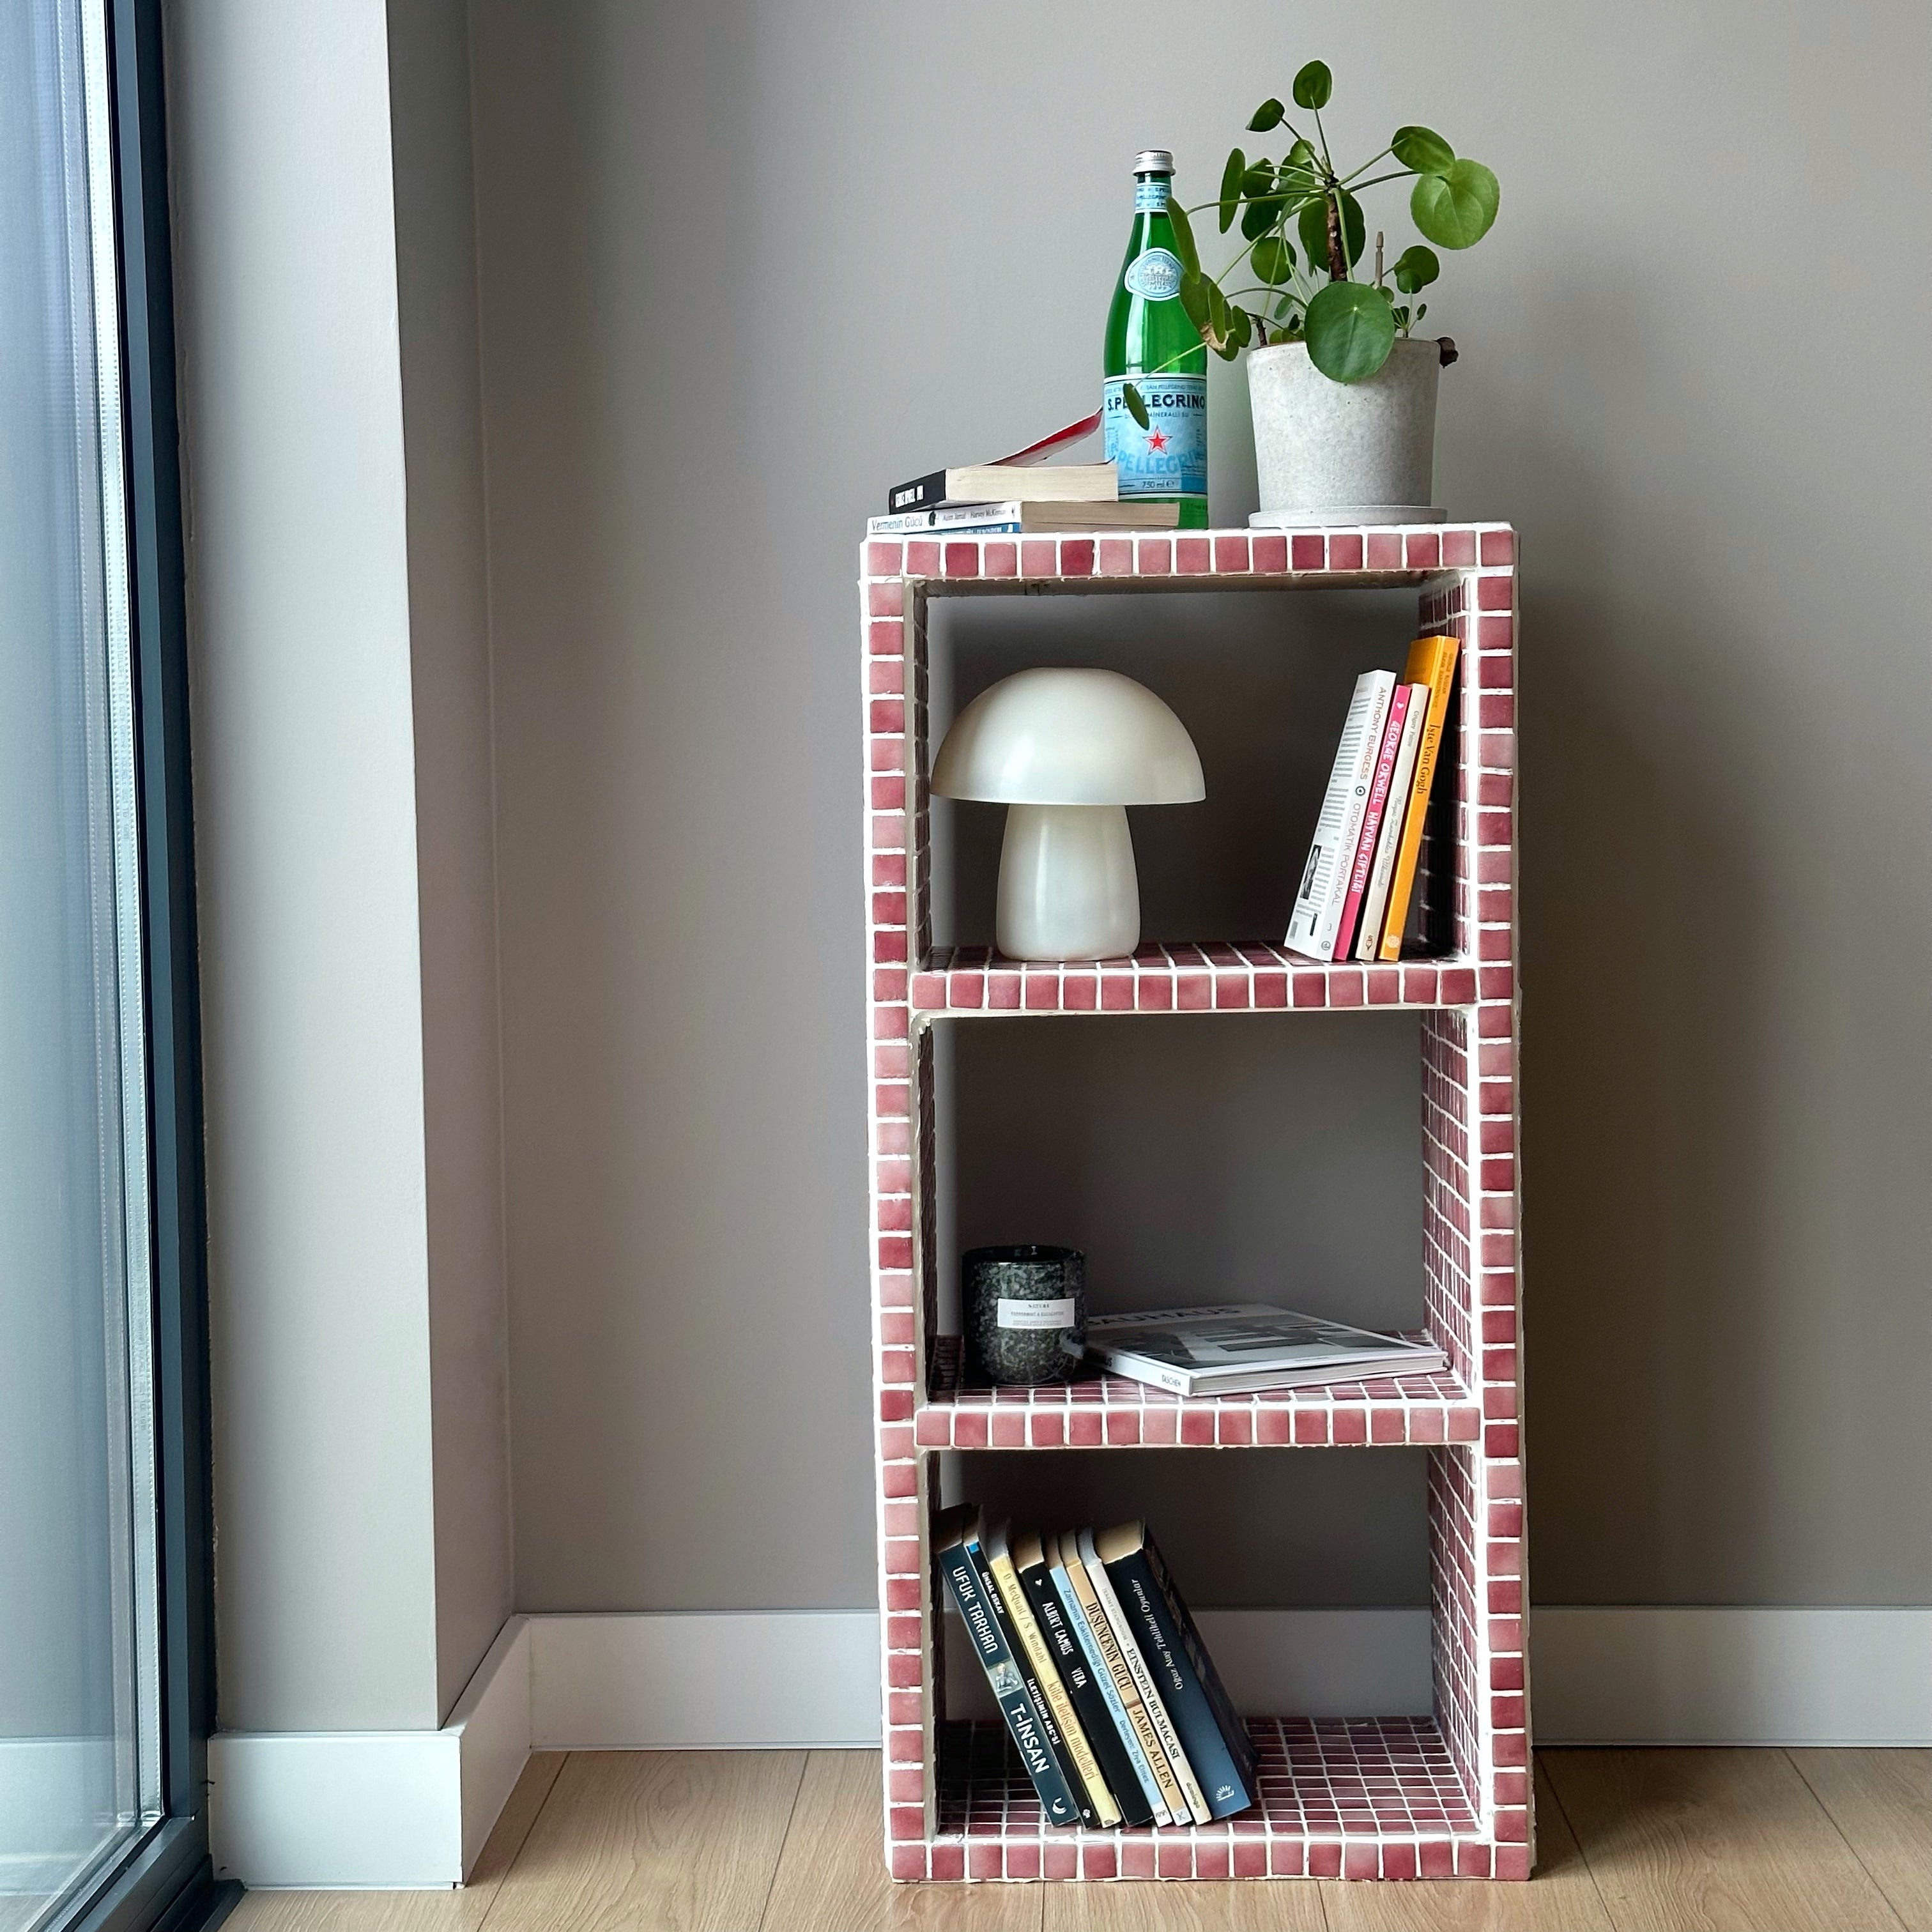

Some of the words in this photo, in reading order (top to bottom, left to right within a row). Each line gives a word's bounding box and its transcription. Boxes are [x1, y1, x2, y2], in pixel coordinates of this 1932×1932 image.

[1371, 686, 1387, 733] ANTHONY
[1382, 719, 1402, 762] GEORGE
[1422, 745, 1436, 765] Van
[1372, 763, 1390, 805] ORWELL
[1416, 767, 1430, 794] Gogh
[1344, 802, 1361, 852] OTOMATİK
[1360, 810, 1380, 852] HAYVAN
[1331, 854, 1350, 906] PORTAKAL
[953, 1566, 976, 1602] UFUK
[969, 1602, 998, 1653] TARHAN
[1131, 1579, 1150, 1613] Oyunlar
[1027, 1631, 1047, 1664] Windahl
[1042, 1602, 1063, 1629] ALBERT
[1053, 1628, 1075, 1656] CAMUS
[1071, 1667, 1087, 1689] VEBA
[1126, 1648, 1154, 1699] EINSTEIN
[1149, 1700, 1180, 1759] BULMACASI
[1011, 1703, 1049, 1773] T-İNSAN
[1070, 1736, 1099, 1780] modelleri
[1132, 1710, 1156, 1747] JAMES
[1149, 1751, 1174, 1789] ALLEN
